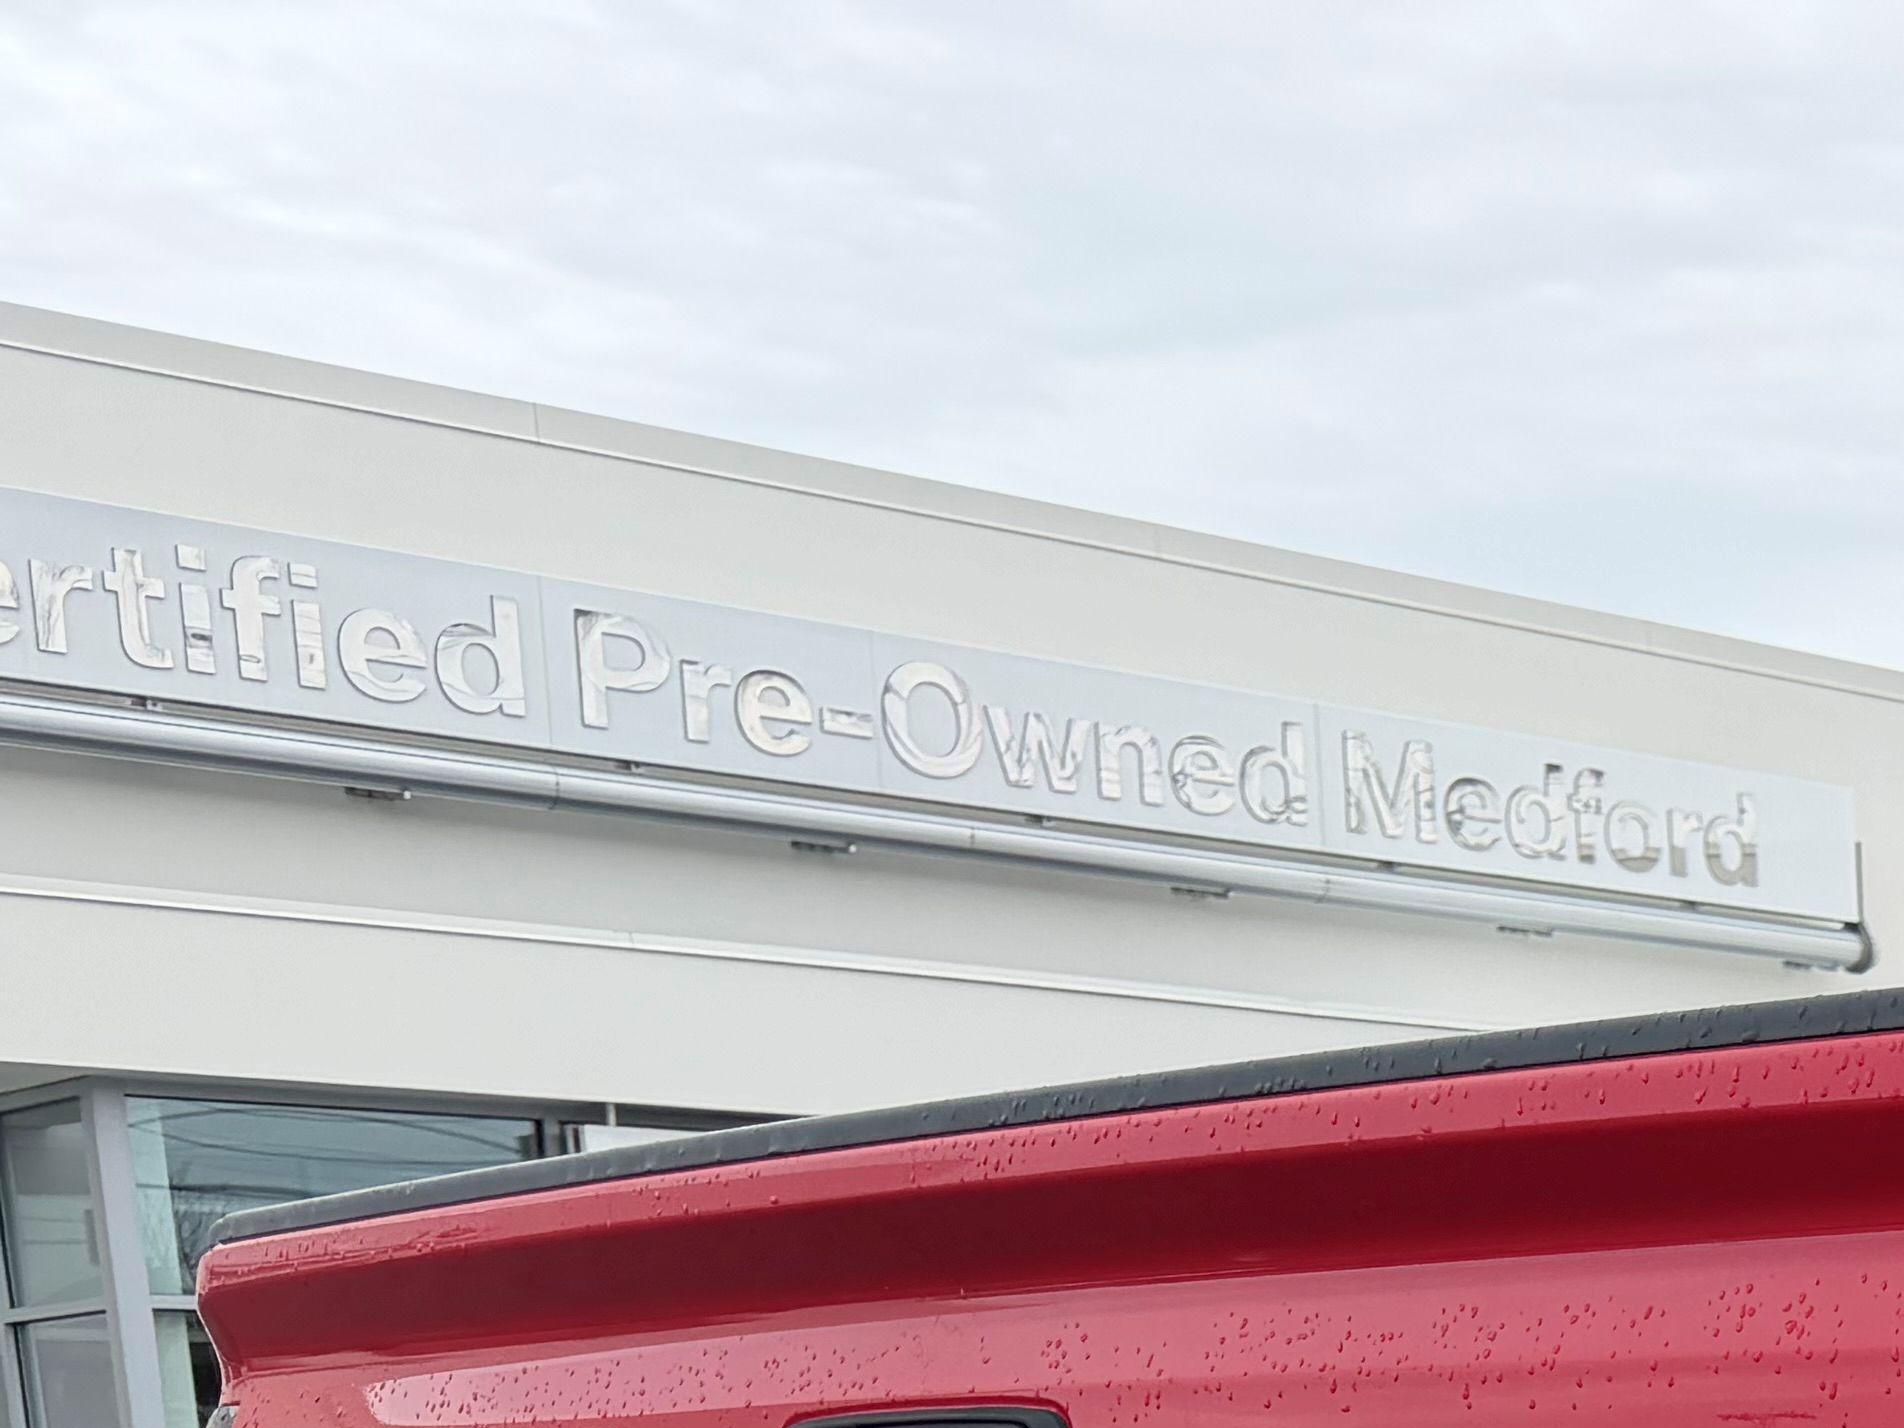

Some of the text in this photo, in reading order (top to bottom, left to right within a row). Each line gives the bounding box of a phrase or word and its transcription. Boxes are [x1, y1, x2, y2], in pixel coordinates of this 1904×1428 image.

[0, 543, 1759, 888] rtified Pre-Owned Medford
